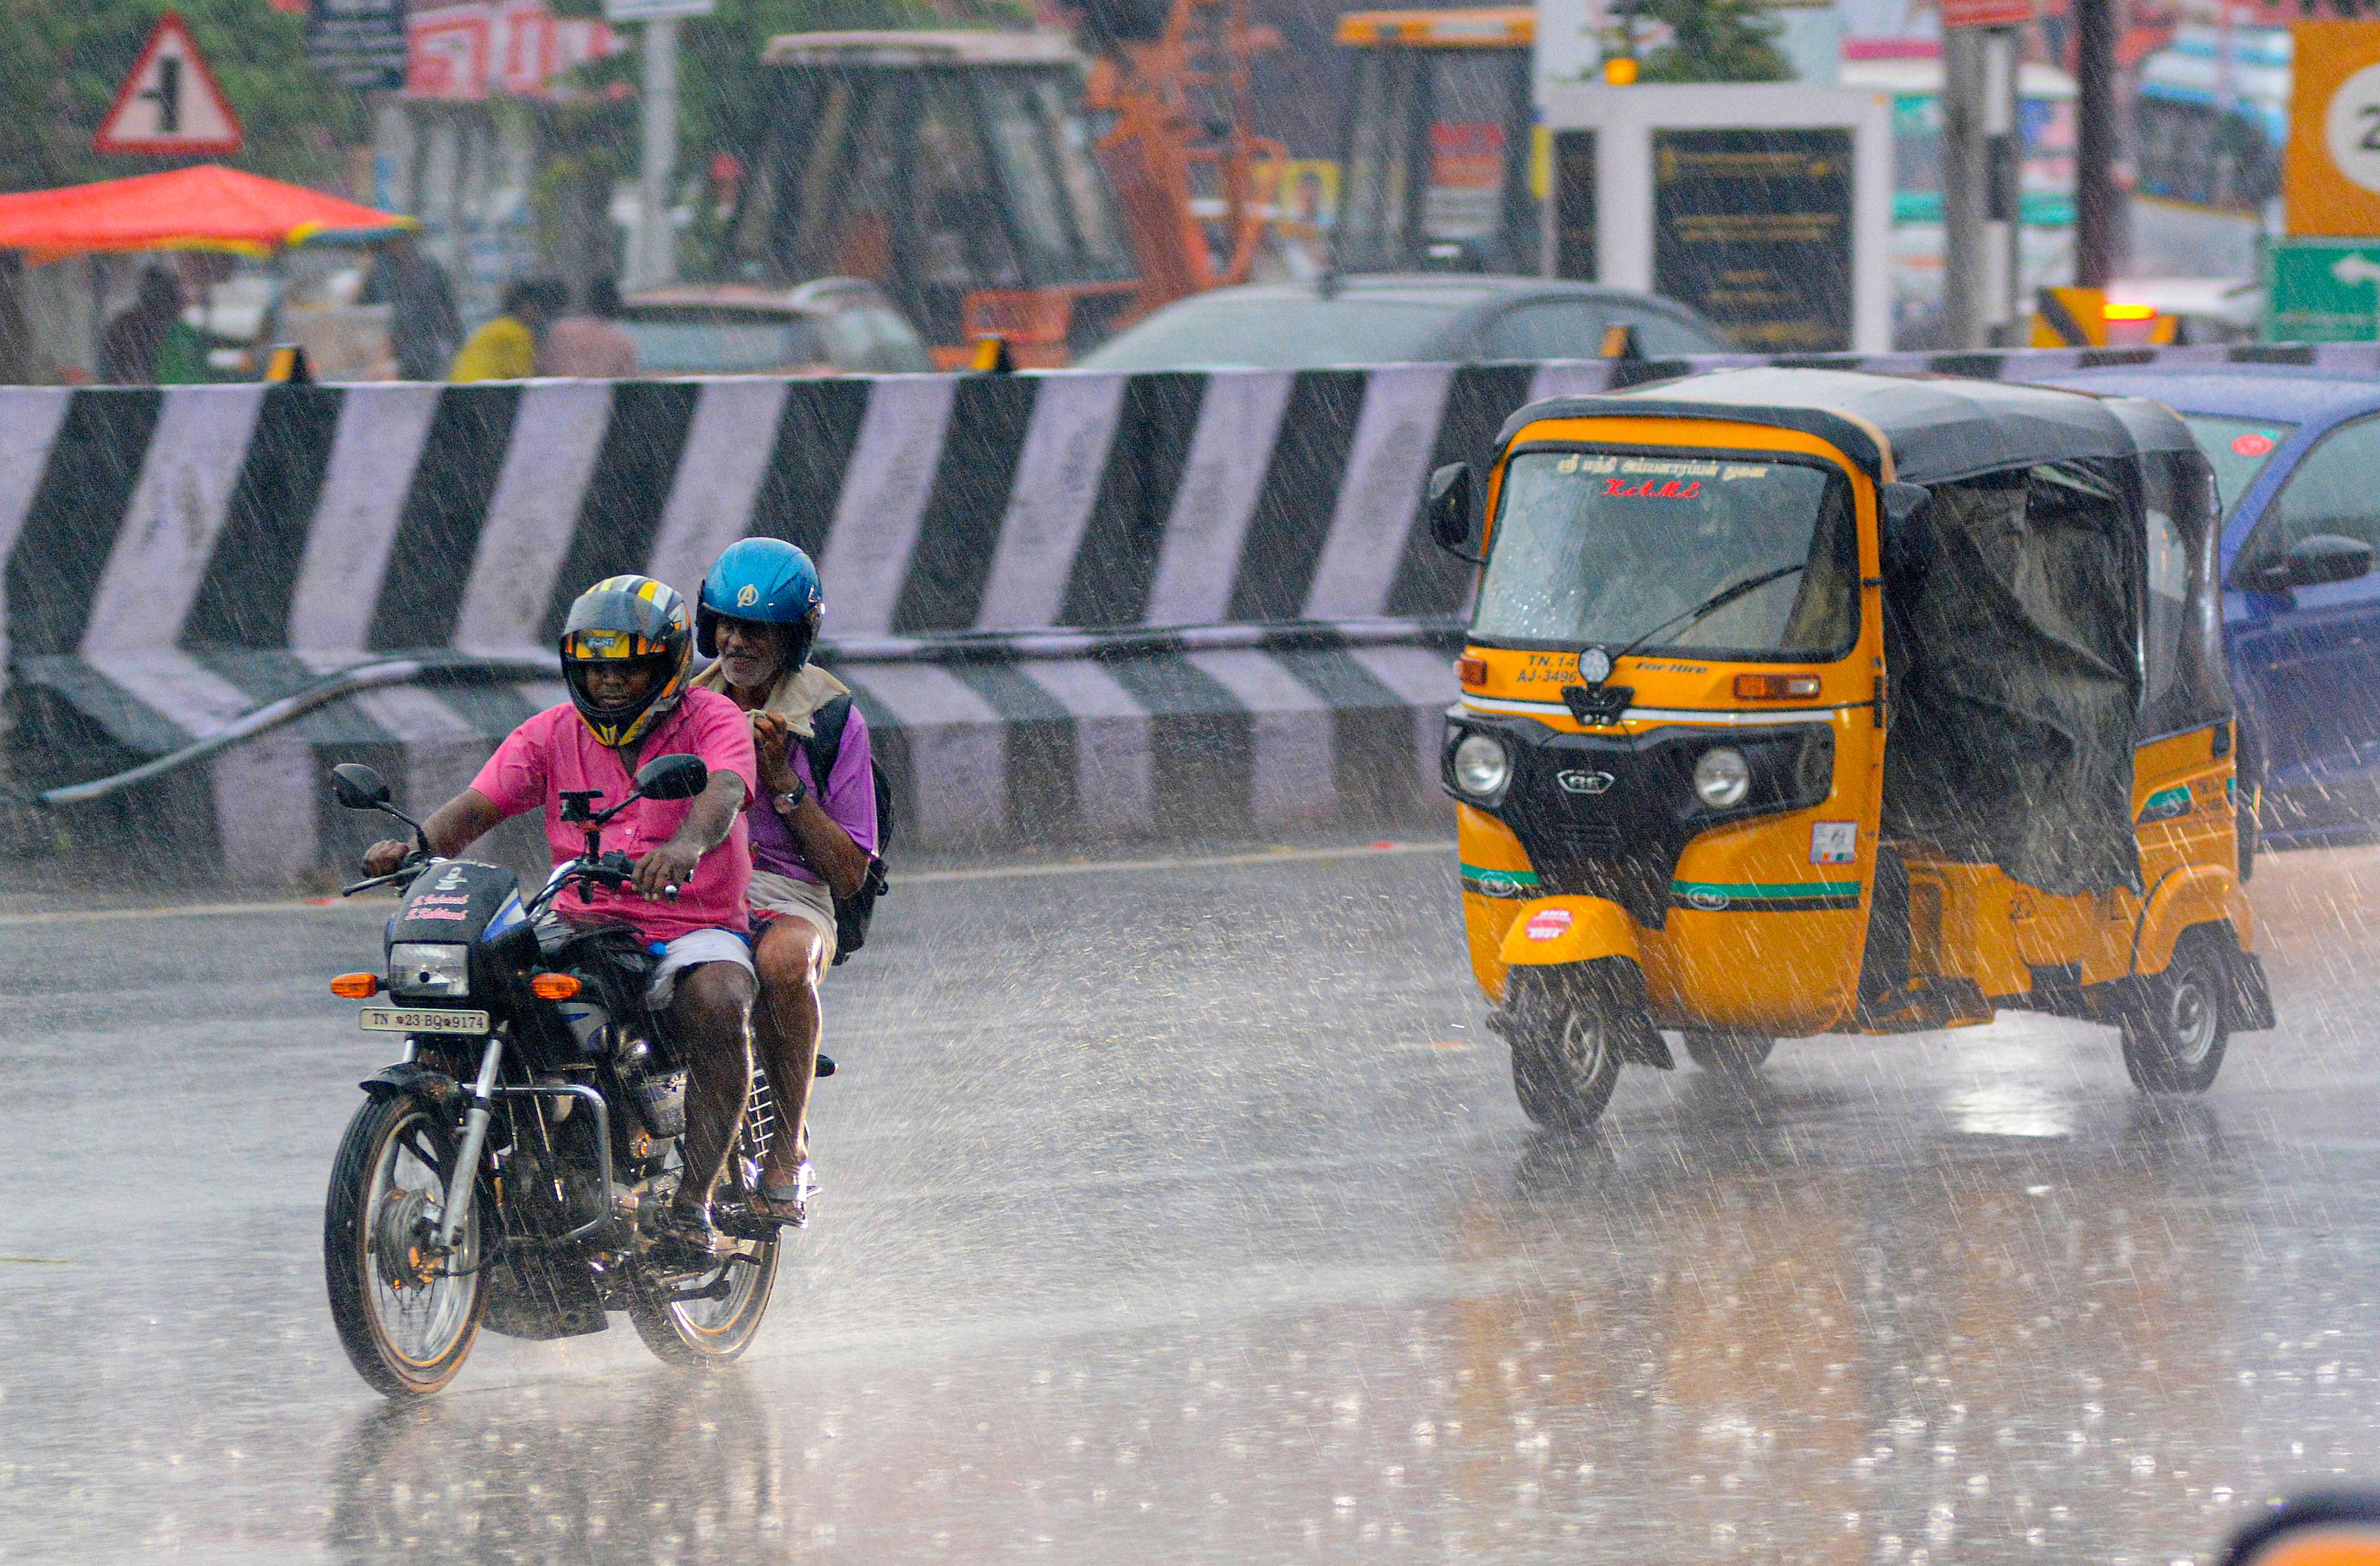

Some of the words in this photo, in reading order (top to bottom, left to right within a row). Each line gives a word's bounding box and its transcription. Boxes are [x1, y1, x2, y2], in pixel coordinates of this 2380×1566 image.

[373, 1014, 388, 1025] TN
[405, 1014, 420, 1026] 23
[452, 1017, 483, 1029] 9174
